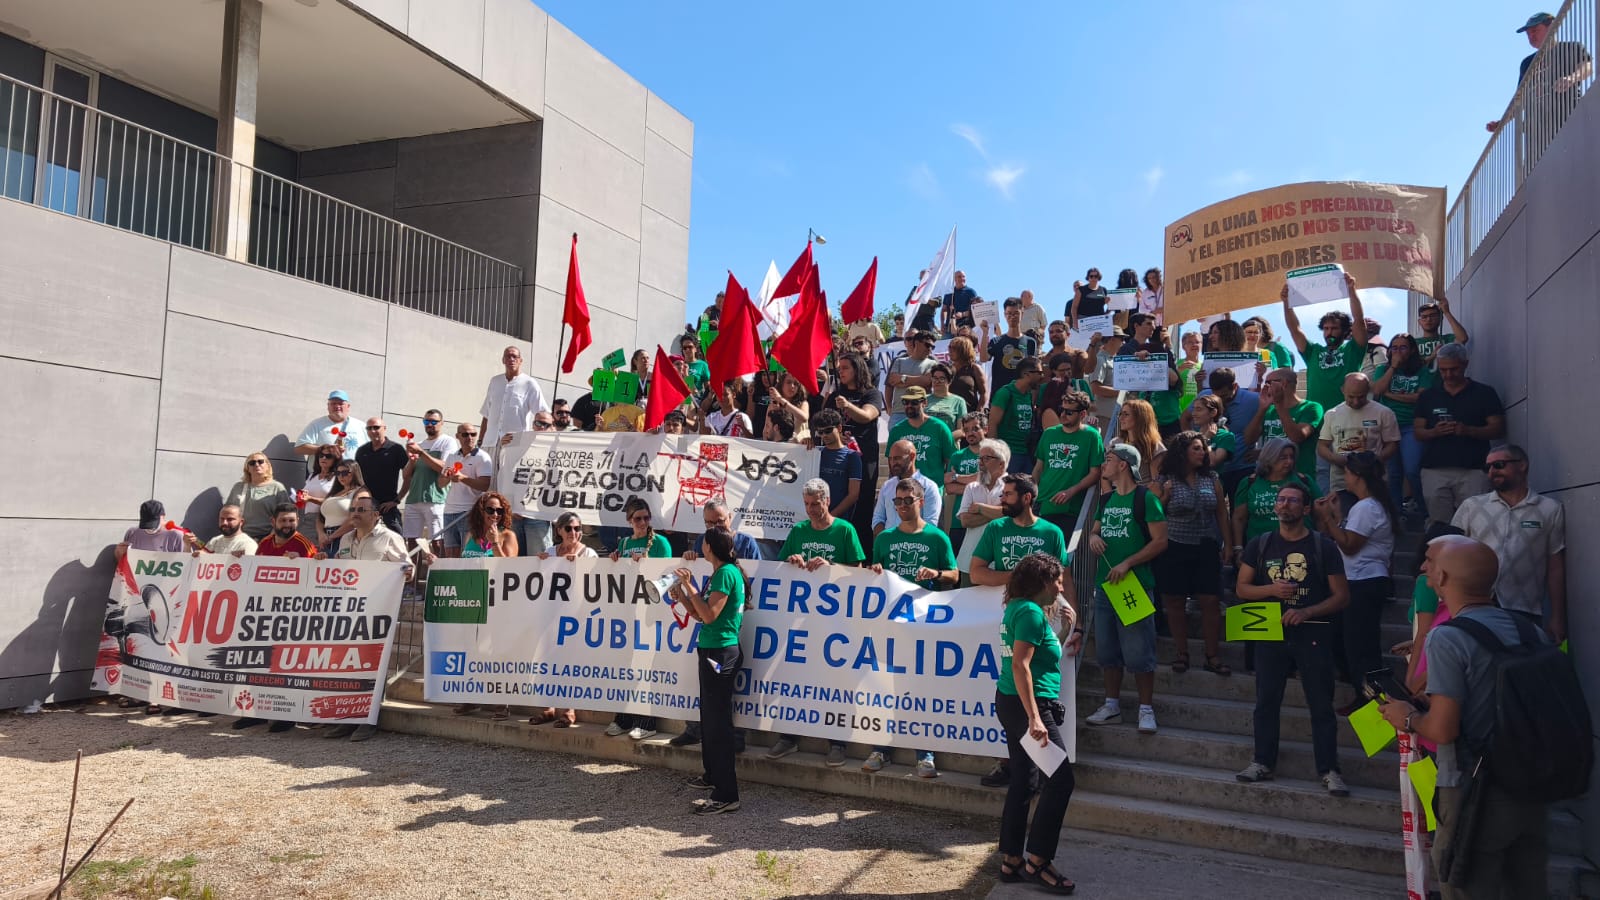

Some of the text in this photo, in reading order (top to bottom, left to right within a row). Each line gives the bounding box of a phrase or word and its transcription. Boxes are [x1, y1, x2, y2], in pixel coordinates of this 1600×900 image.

[1203, 220, 1220, 238] LA
[1222, 209, 1258, 231] UMA
[1261, 201, 1297, 222] NOS
[1301, 197, 1396, 215] PRECARIZA
[1189, 248, 1197, 263] Y
[1199, 243, 1214, 260] EL
[1216, 222, 1299, 255] RENTISMO
[1303, 218, 1340, 235] NOS
[1175, 244, 1337, 297] INVESTIGADORES
[1342, 242, 1369, 261] EN
[621, 381, 630, 397] 1
[520, 459, 542, 467] LOS
[545, 459, 593, 469] ATAQUES
[619, 451, 651, 471] LA
[549, 451, 594, 461] CONTRA
[740, 514, 796, 524] ESTUDIANTIL
[889, 542, 930, 553] UNIVERSIDAD
[1001, 536, 1045, 547] UNIVERSIDAD
[135, 559, 184, 578] NAS
[197, 563, 225, 581] UGT
[257, 570, 298, 582] CCOO
[316, 567, 359, 586] USO
[434, 585, 457, 597] UMA
[488, 572, 572, 607] ¡POR
[583, 573, 649, 605] UNA
[244, 596, 367, 613] AL RECORTE DE
[448, 597, 481, 608] PÚBLICA
[1123, 590, 1137, 609] #
[178, 589, 240, 645] NO
[238, 615, 392, 642] SEGURIDAD
[225, 650, 265, 665] EN LA
[279, 647, 372, 671] U.M.A.
[752, 626, 808, 664] DE
[823, 632, 999, 681] CALIDA
[139, 659, 170, 673] SEGURIDAD
[182, 668, 191, 676] ES
[224, 673, 234, 681] ES
[236, 674, 247, 682] UN
[249, 675, 285, 686] DERECHO
[287, 678, 293, 686] Y
[294, 678, 310, 688] UNA
[312, 680, 361, 690] NECESIDAD
[445, 654, 678, 685] SI CONDICIONES LABORALES JUSTAS
[443, 677, 700, 710] UNIÓN DE LA COMUNIDAD UNIVERSITARIA
[753, 680, 926, 713] INFRAFINANCIACIÓN
[932, 698, 956, 714] DE
[962, 701, 985, 717] LA
[335, 706, 348, 714] EN
[733, 701, 1008, 744] MPLICIDAD DE LOS RECTORADOS
